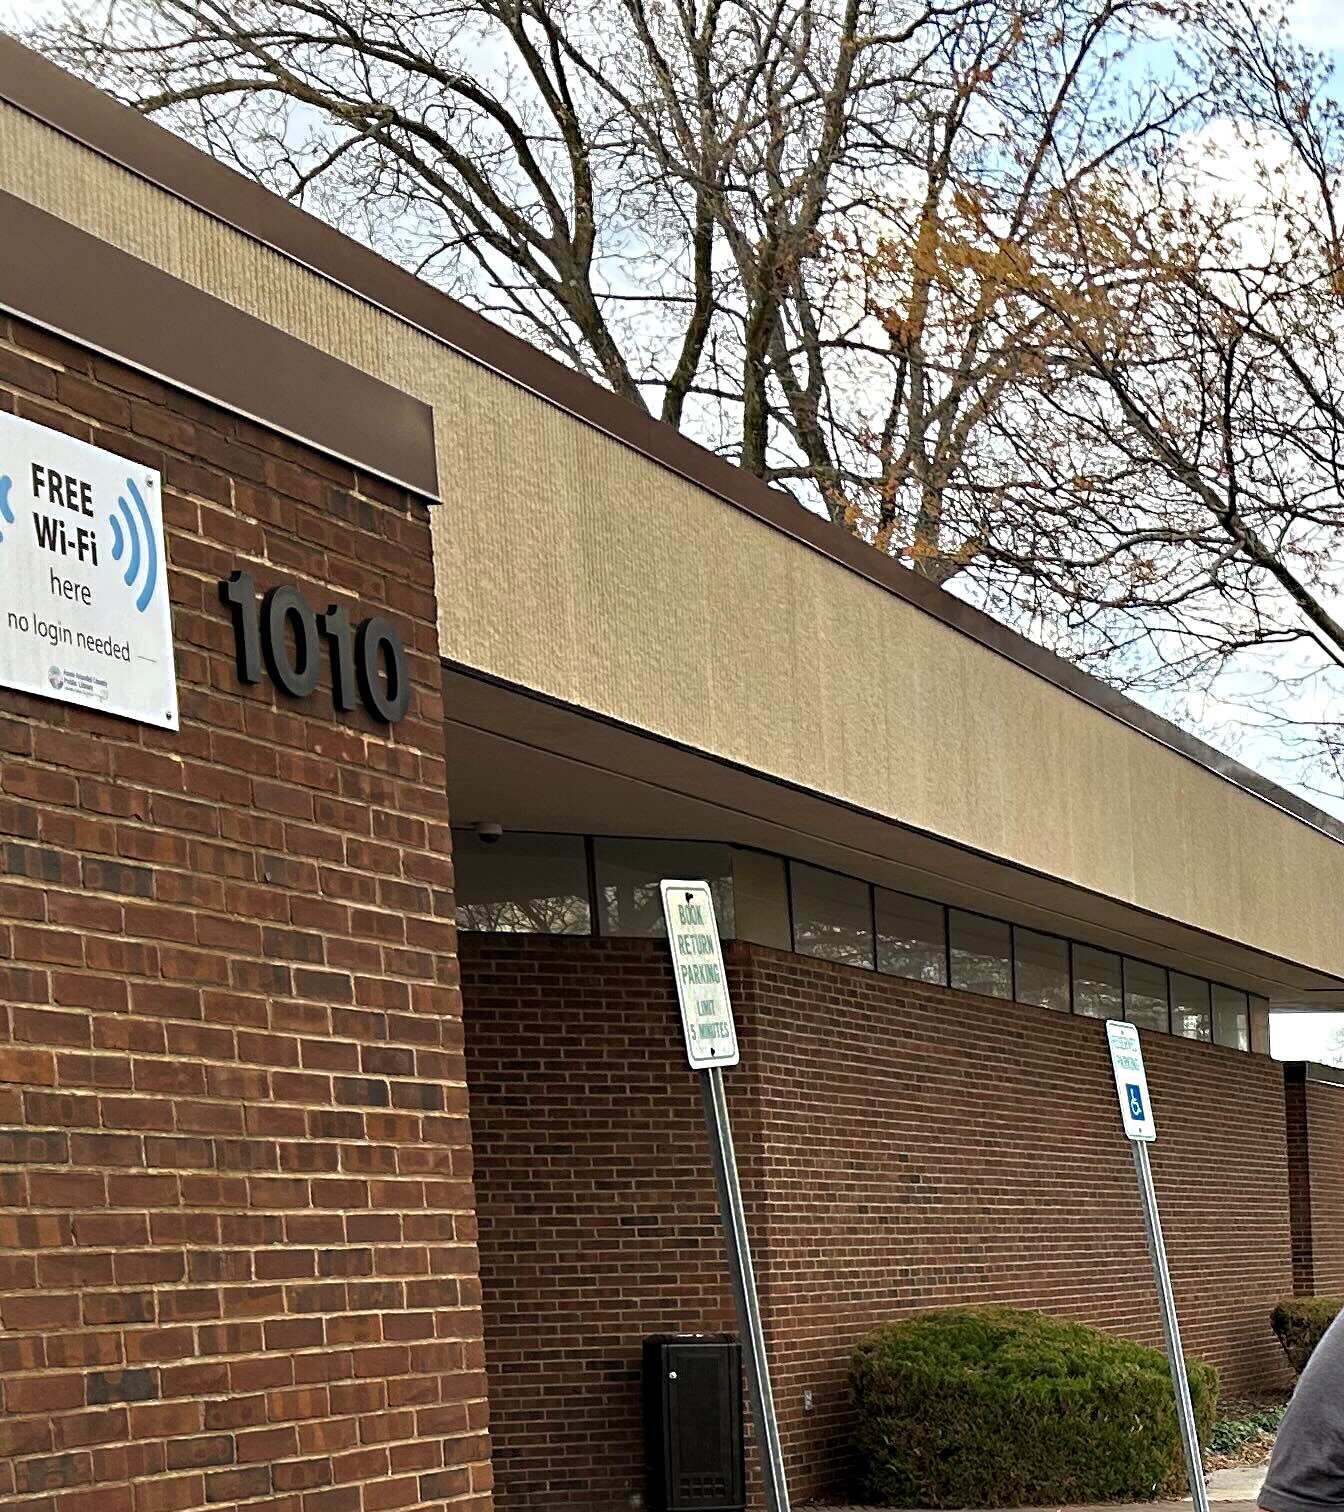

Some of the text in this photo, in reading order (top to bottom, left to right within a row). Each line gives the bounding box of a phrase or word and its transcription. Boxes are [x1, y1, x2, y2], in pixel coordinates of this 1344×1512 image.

[31, 463, 94, 517] FREE
[32, 512, 98, 566] Wi-Fi
[50, 567, 91, 606] here
[8, 610, 131, 662] no login needed
[218, 570, 410, 723] 1010
[678, 904, 704, 926] BOOK
[678, 935, 714, 955] RETURN
[681, 964, 720, 985] PARKING
